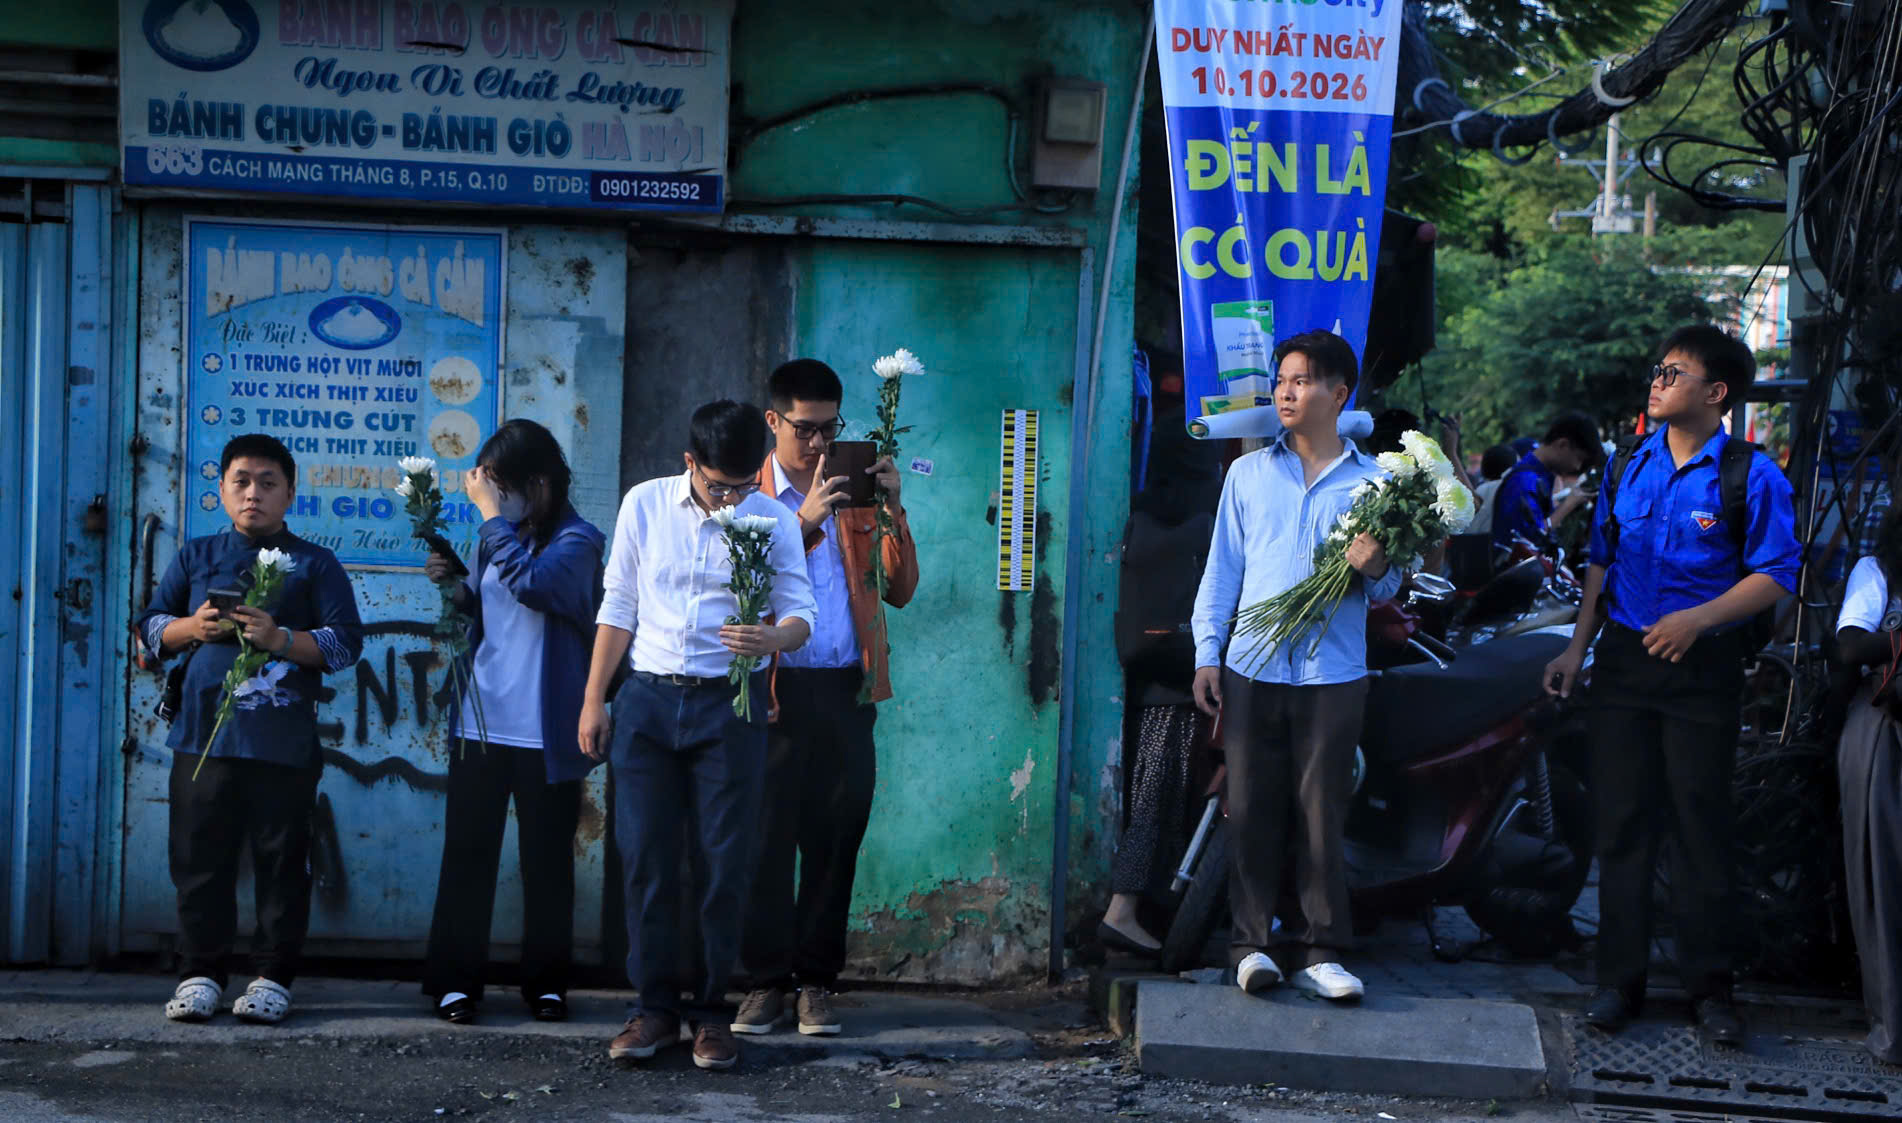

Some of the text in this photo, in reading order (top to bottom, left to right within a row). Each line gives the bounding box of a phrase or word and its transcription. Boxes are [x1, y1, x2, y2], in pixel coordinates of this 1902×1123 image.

[1171, 22, 1385, 61] DUY NHẤT NGÀY
[294, 56, 686, 114] Ngon Vì Chất Lượng
[1191, 67, 1367, 101] 10.10.2026
[148, 91, 244, 141] BÁNH
[507, 112, 573, 159] GIÒ
[582, 114, 632, 161] HÀ
[639, 117, 704, 170] NỘI
[147, 143, 203, 176] 663
[209, 154, 262, 178] CÁCH
[268, 161, 323, 184] MẠNG
[330, 160, 394, 185] THÁNG
[399, 169, 414, 188] 8,
[468, 171, 508, 192] Q.10
[533, 175, 590, 195] ĐTDĐ:
[600, 179, 701, 201] 0901232592
[1184, 121, 1371, 196] ĐẾN LÀ
[1180, 212, 1369, 282] CÓ QUÀ
[230, 353, 237, 371] 1
[307, 352, 340, 378] HỘT
[346, 357, 372, 380] VỊT
[231, 379, 269, 398] XÚC
[275, 380, 320, 400] XÍCH
[327, 384, 369, 405] THỊT
[230, 405, 416, 432] 3 TRỨNG CÚT
[326, 438, 368, 459] THỊT
[332, 491, 395, 519] GIÒ
[434, 501, 477, 524] 2K
